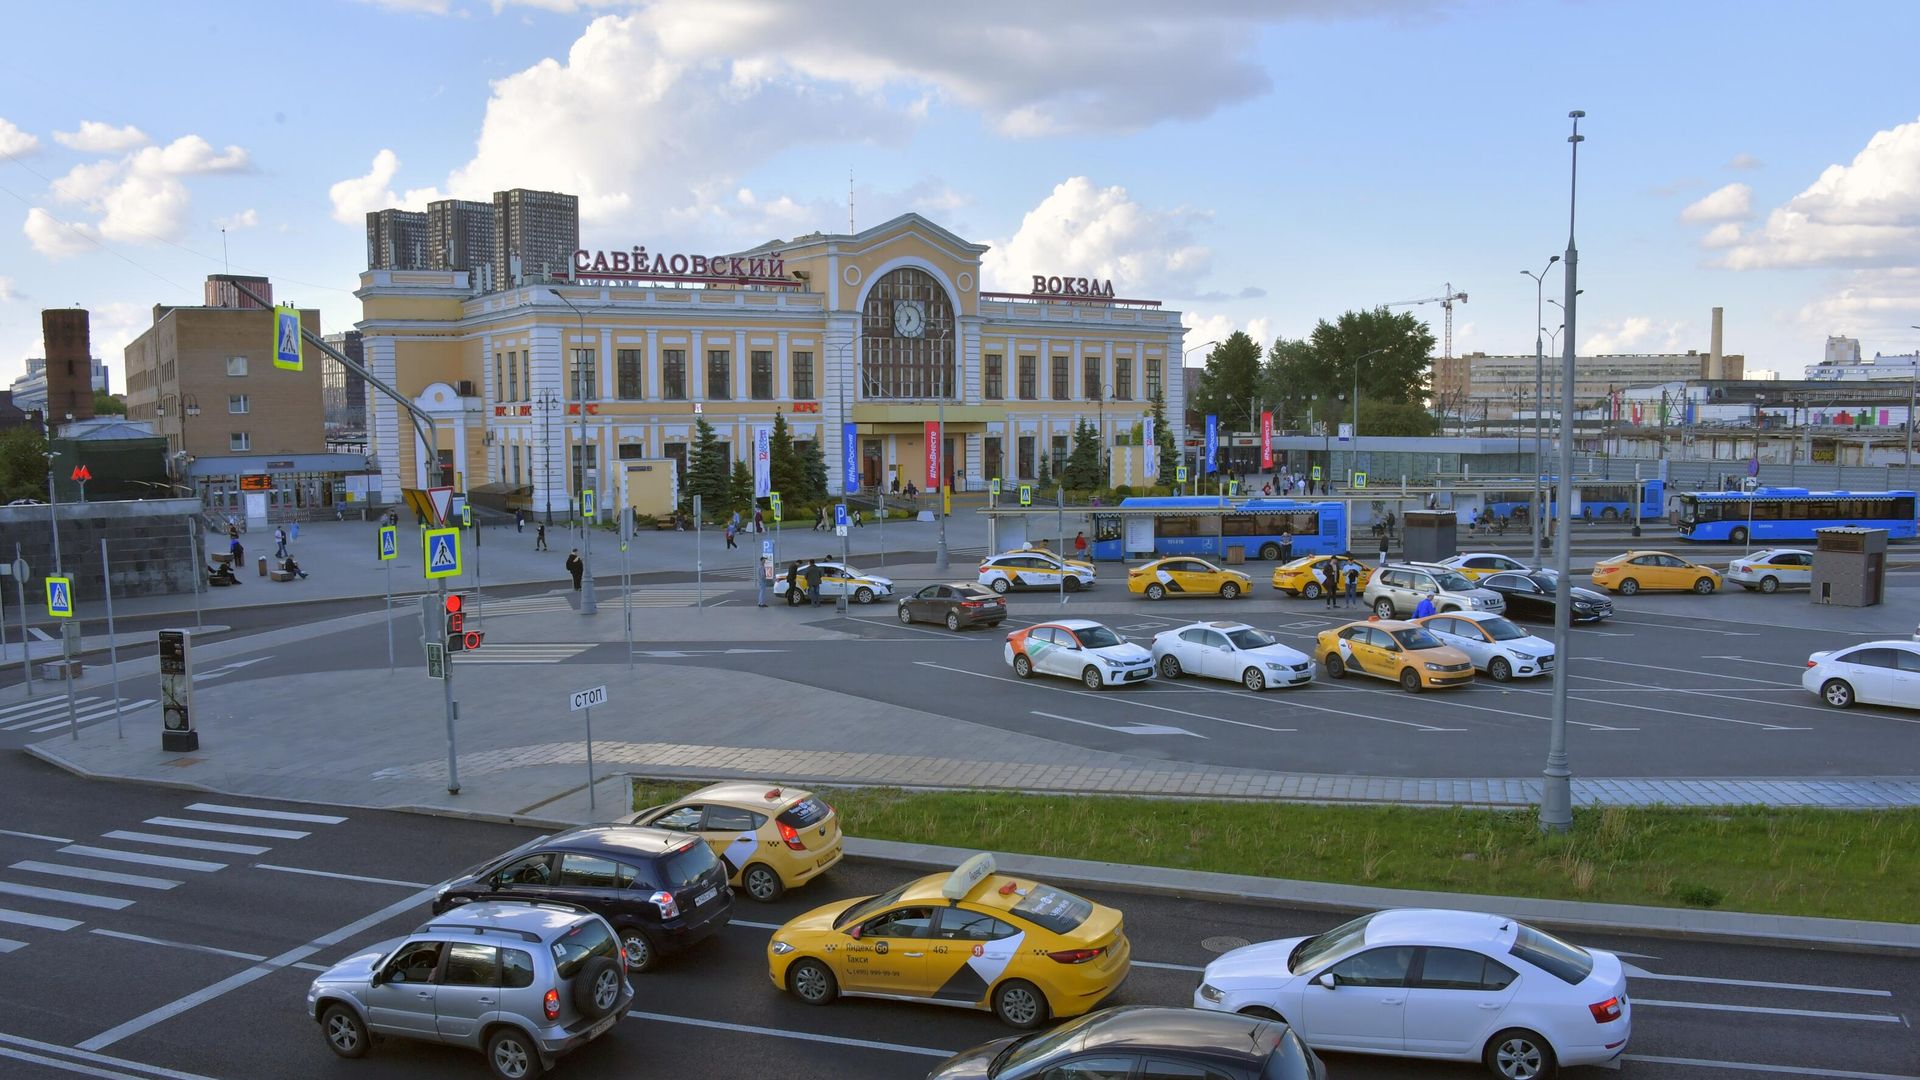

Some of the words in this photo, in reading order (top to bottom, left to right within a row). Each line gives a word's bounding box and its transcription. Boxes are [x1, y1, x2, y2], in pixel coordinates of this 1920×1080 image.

[573, 246, 785, 278] САВЁЛОВСКИЙ
[1032, 275, 1115, 297] ВОКЗАЛ
[793, 402, 818, 414] KFC
[838, 507, 845, 524] P
[575, 688, 602, 707] СТОП
[846, 943, 873, 953] Яндекс
[876, 943, 887, 953] Go
[933, 946, 949, 954] 462
[974, 947, 981, 955] Я
[846, 955, 869, 964] Такси
